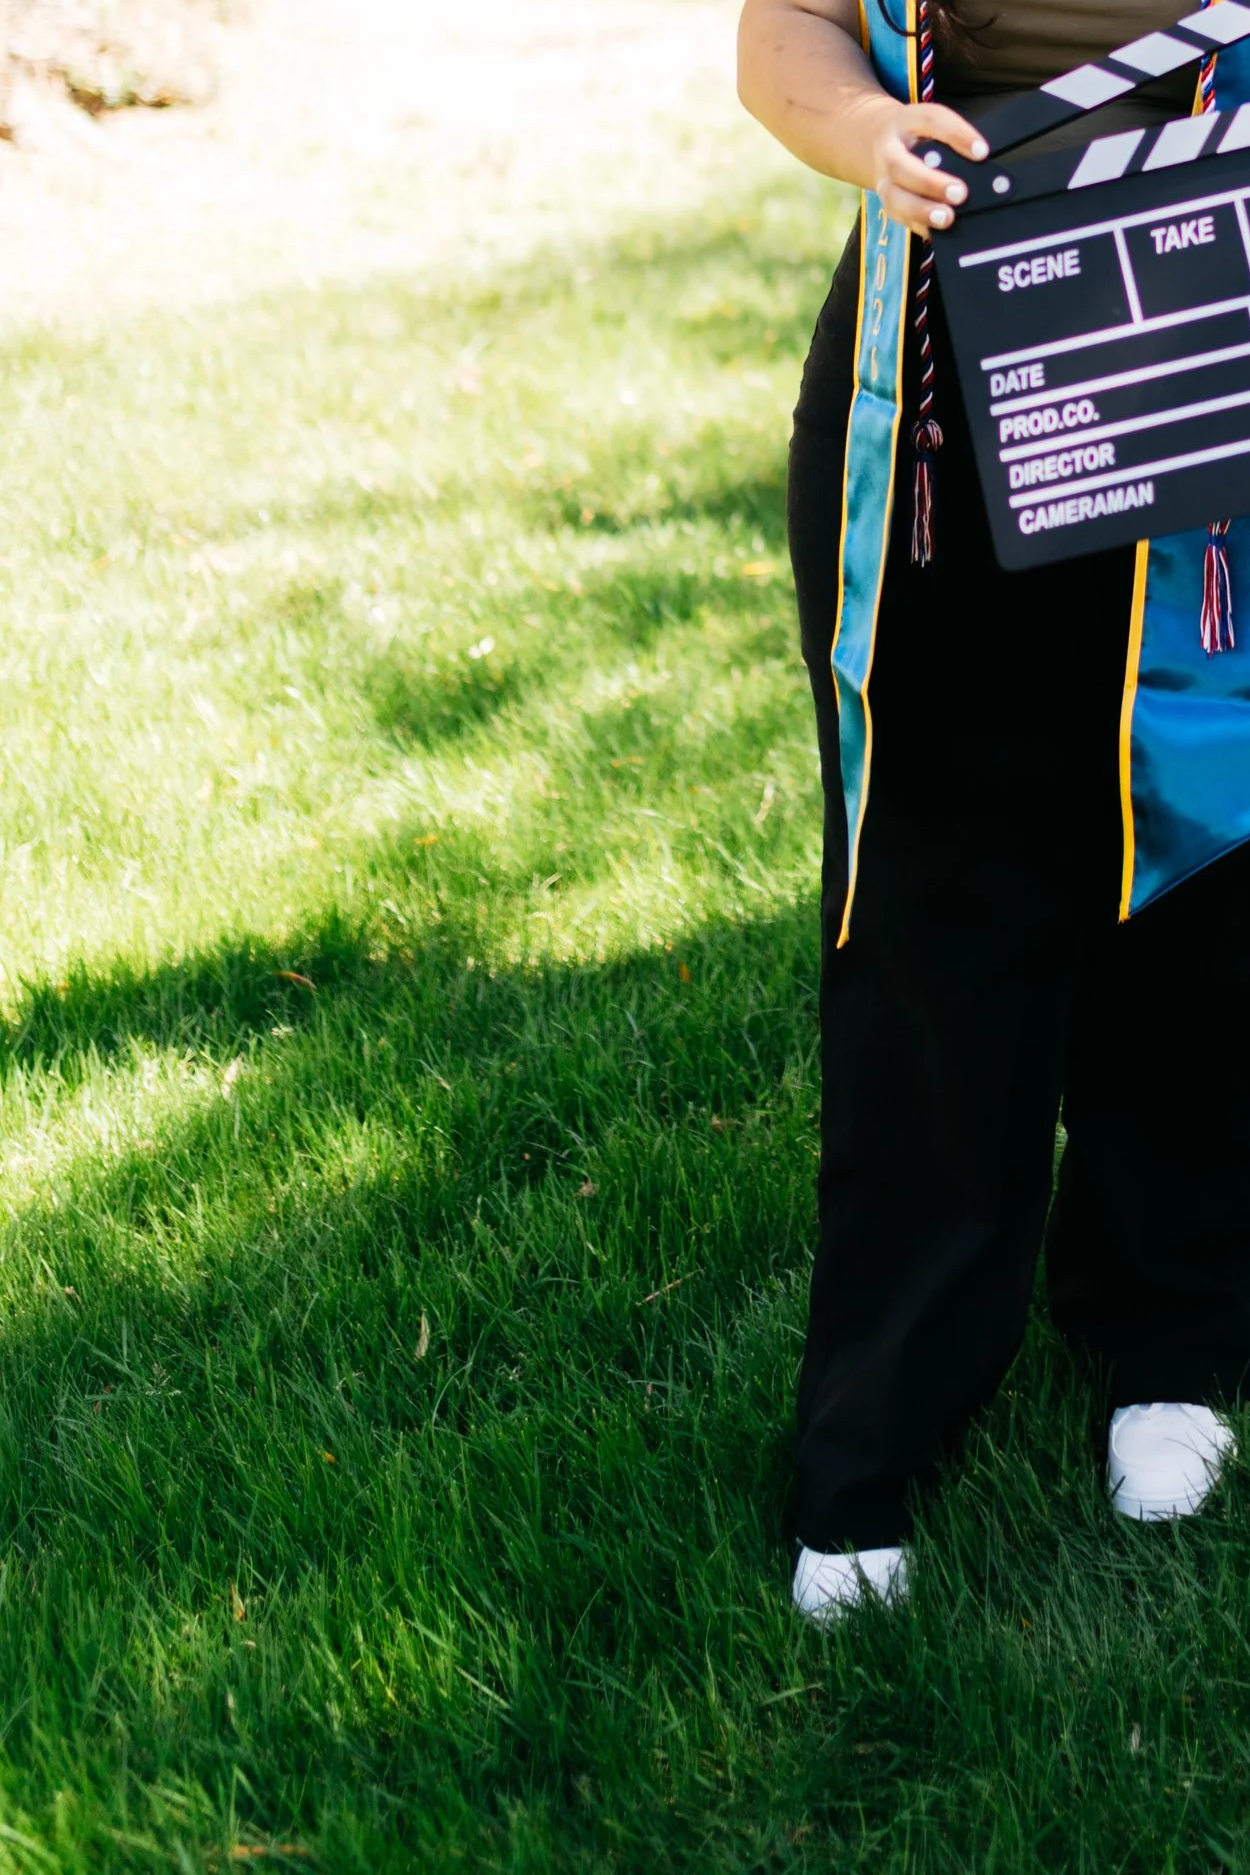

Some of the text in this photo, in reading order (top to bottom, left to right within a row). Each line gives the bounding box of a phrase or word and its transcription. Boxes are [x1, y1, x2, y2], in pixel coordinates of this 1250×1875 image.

[1150, 216, 1215, 254] TAKE
[998, 249, 1080, 291] SCENE
[990, 363, 1045, 397] DATE
[1000, 399, 1100, 443] PROD.CO.
[1009, 442, 1115, 489] DIRECTOR
[1019, 481, 1154, 534] CAMERAMAN
